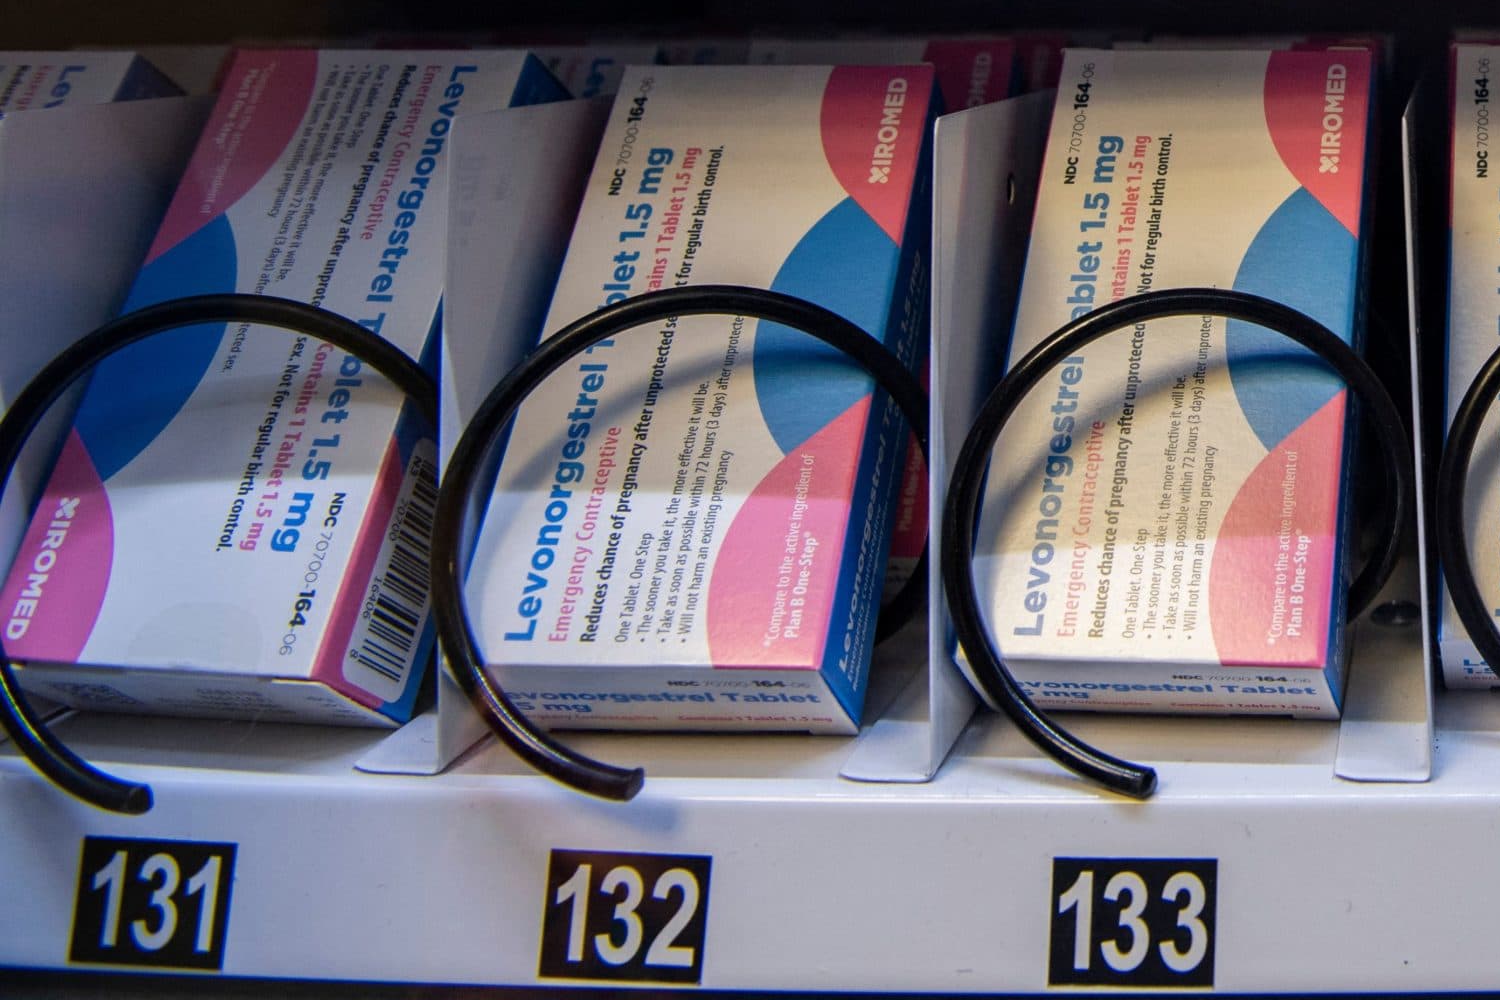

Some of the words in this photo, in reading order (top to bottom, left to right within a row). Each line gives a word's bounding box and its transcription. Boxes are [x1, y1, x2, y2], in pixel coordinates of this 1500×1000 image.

[395, 64, 441, 137] Emergency
[615, 77, 655, 166] 70700-164-06
[1064, 61, 1096, 154] 70700-164-06
[1473, 56, 1491, 148] 70700-164-06
[1063, 156, 1078, 184] NDC
[1093, 136, 1123, 182] mg
[1126, 161, 1143, 181] 1.5
[1133, 135, 1151, 157] mg
[1476, 150, 1488, 177] NDC
[359, 141, 411, 240] Contraceptive
[367, 65, 476, 302] Levonorgestrel
[607, 168, 625, 195] NDC
[1080, 192, 1109, 232] 1.5
[1117, 186, 1140, 232] Tablet
[1067, 241, 1102, 320] ablet
[288, 337, 307, 361] sex.
[271, 389, 290, 408] for
[279, 363, 300, 387] Not
[296, 340, 332, 412] Contains
[502, 363, 607, 640] Levonorgestrel
[619, 203, 652, 242] 1.5
[638, 148, 673, 193] mg
[252, 410, 279, 459] regular
[266, 432, 302, 486] Tablet
[302, 434, 340, 480] 1.5
[237, 462, 263, 495] birth
[1013, 356, 1084, 635] Levonorgestrel
[1072, 420, 1106, 536] Contraceptive
[215, 497, 244, 551] control.
[255, 492, 278, 517] 1.5
[269, 493, 313, 552] mg
[323, 492, 345, 526] NDC
[238, 522, 263, 550] mg
[546, 545, 595, 641] Emergency
[575, 426, 623, 541] Contraceptive
[277, 530, 336, 658] 70700-164-06
[789, 597, 803, 606] B
[1056, 540, 1093, 637] Emergency
[783, 609, 801, 638] Plan
[721, 692, 822, 704] Tablet
[91, 850, 223, 953] 131
[556, 864, 700, 968] 132
[1057, 871, 1208, 973] 133
